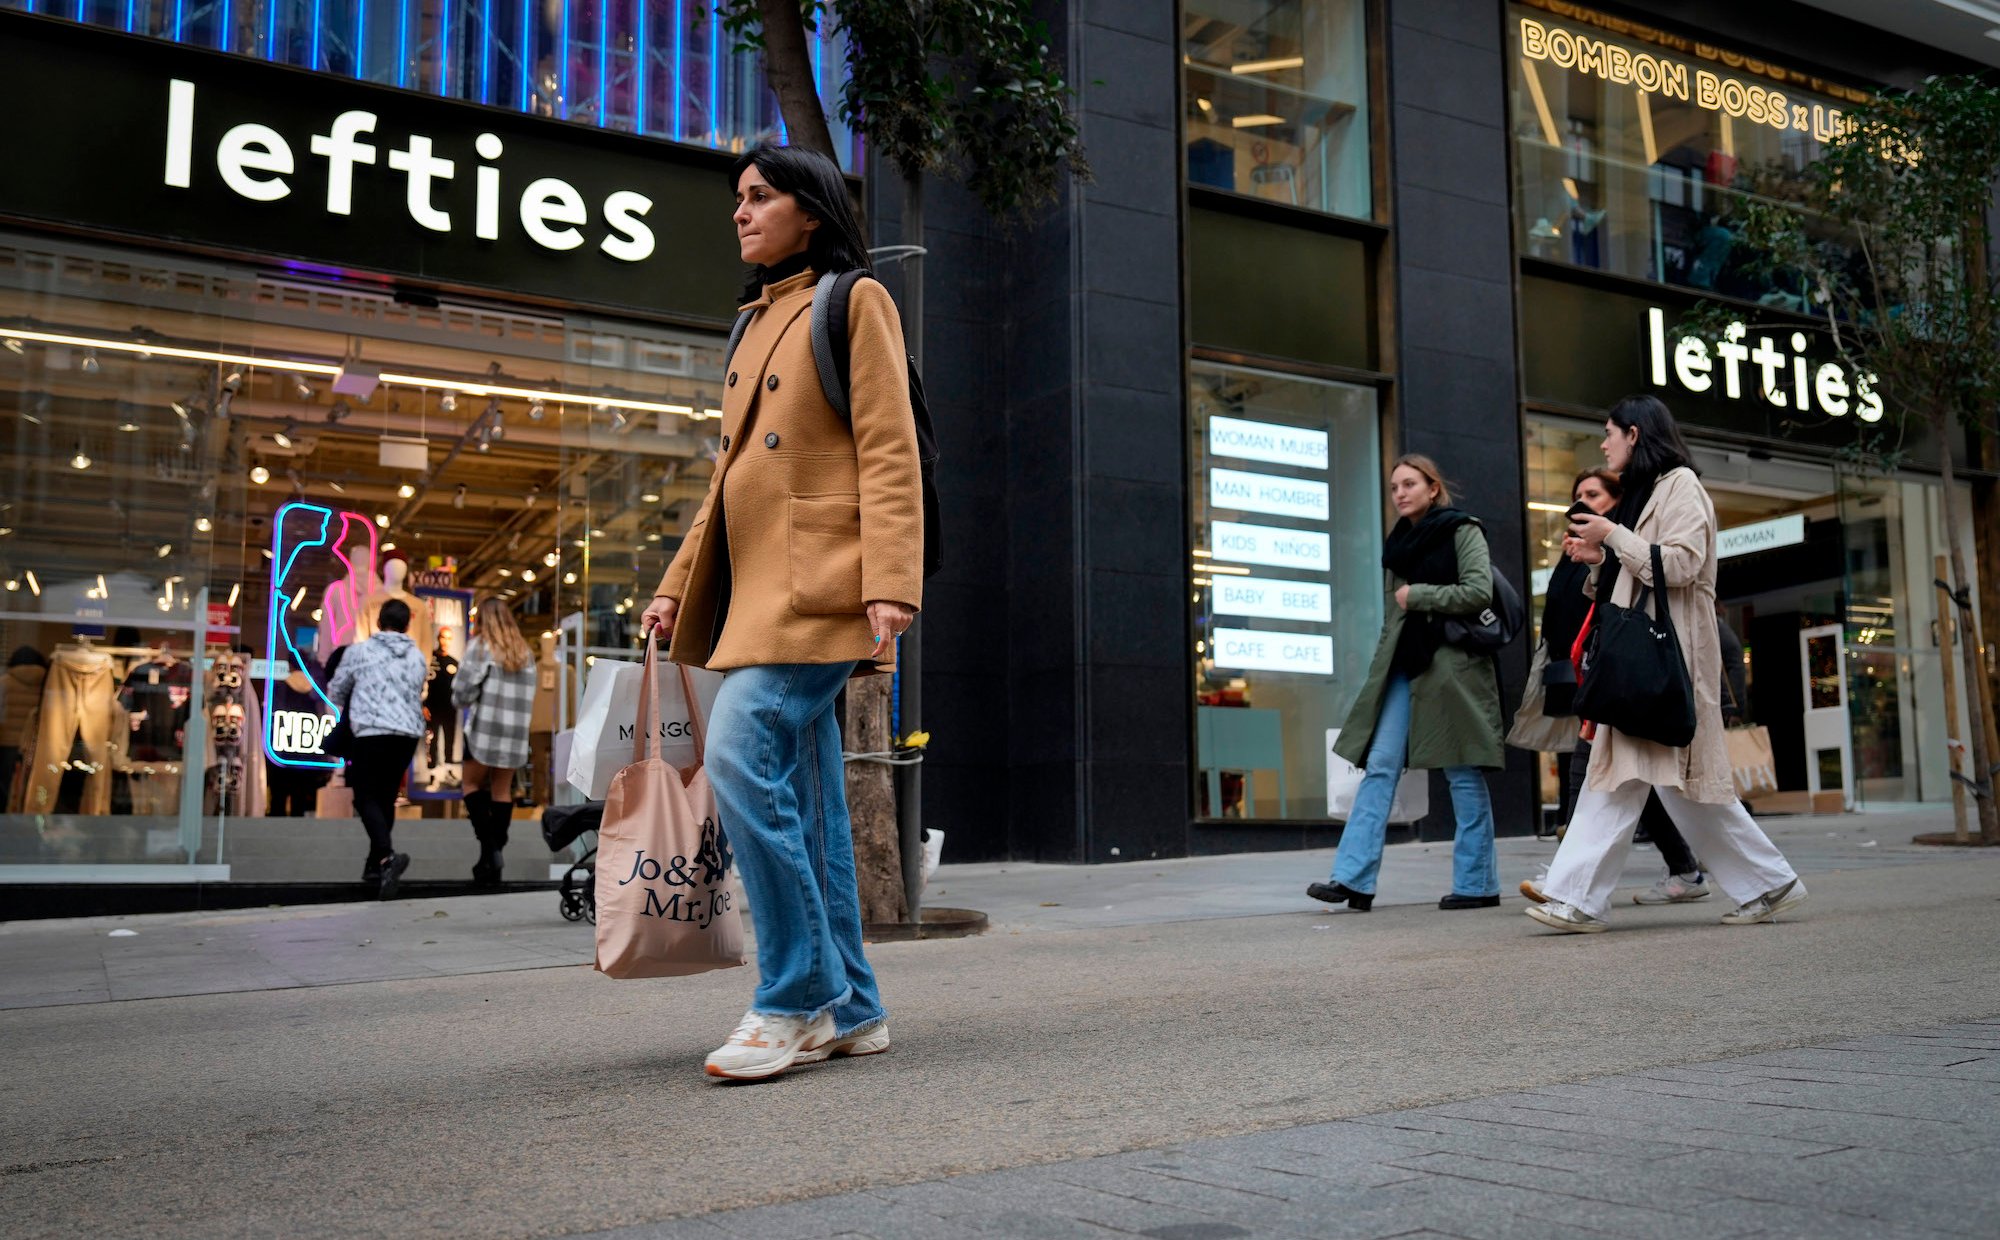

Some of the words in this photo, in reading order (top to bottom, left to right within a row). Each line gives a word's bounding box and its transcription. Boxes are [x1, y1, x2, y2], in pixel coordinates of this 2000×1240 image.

[1520, 18, 1690, 101] BOMBON
[1696, 70, 1789, 130] BOSS
[164, 77, 656, 262] lefties
[1650, 307, 1884, 422] lefties
[1213, 430, 1274, 450] WOMAN
[1215, 481, 1251, 498] MAN
[1260, 487, 1325, 508] HOMBRE
[1221, 535, 1257, 552] KIDS
[1722, 526, 1776, 550] WOMAN
[1224, 587, 1265, 604] BABY
